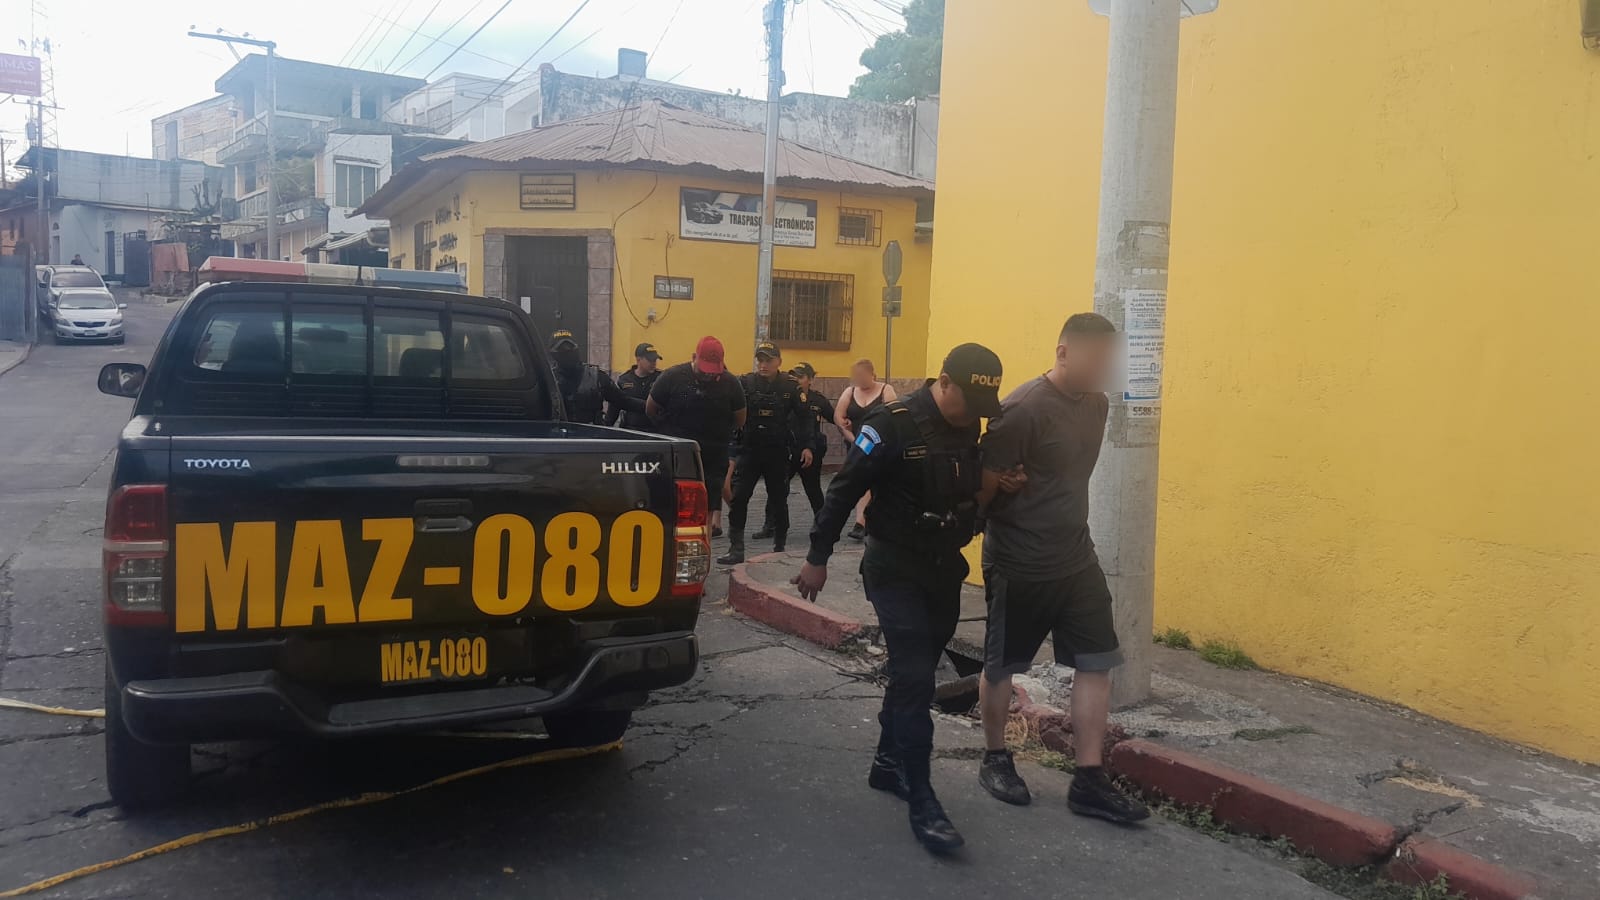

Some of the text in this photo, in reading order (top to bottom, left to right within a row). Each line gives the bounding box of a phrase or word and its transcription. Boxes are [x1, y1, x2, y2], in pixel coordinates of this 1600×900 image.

[774, 216, 815, 231] ECTRÓNICOS
[970, 373, 1001, 387] POLIC
[183, 458, 253, 470] TOYOTA
[602, 462, 661, 474] HILUX
[175, 510, 664, 633] MAZ-080
[381, 636, 487, 682] MAZ-080
